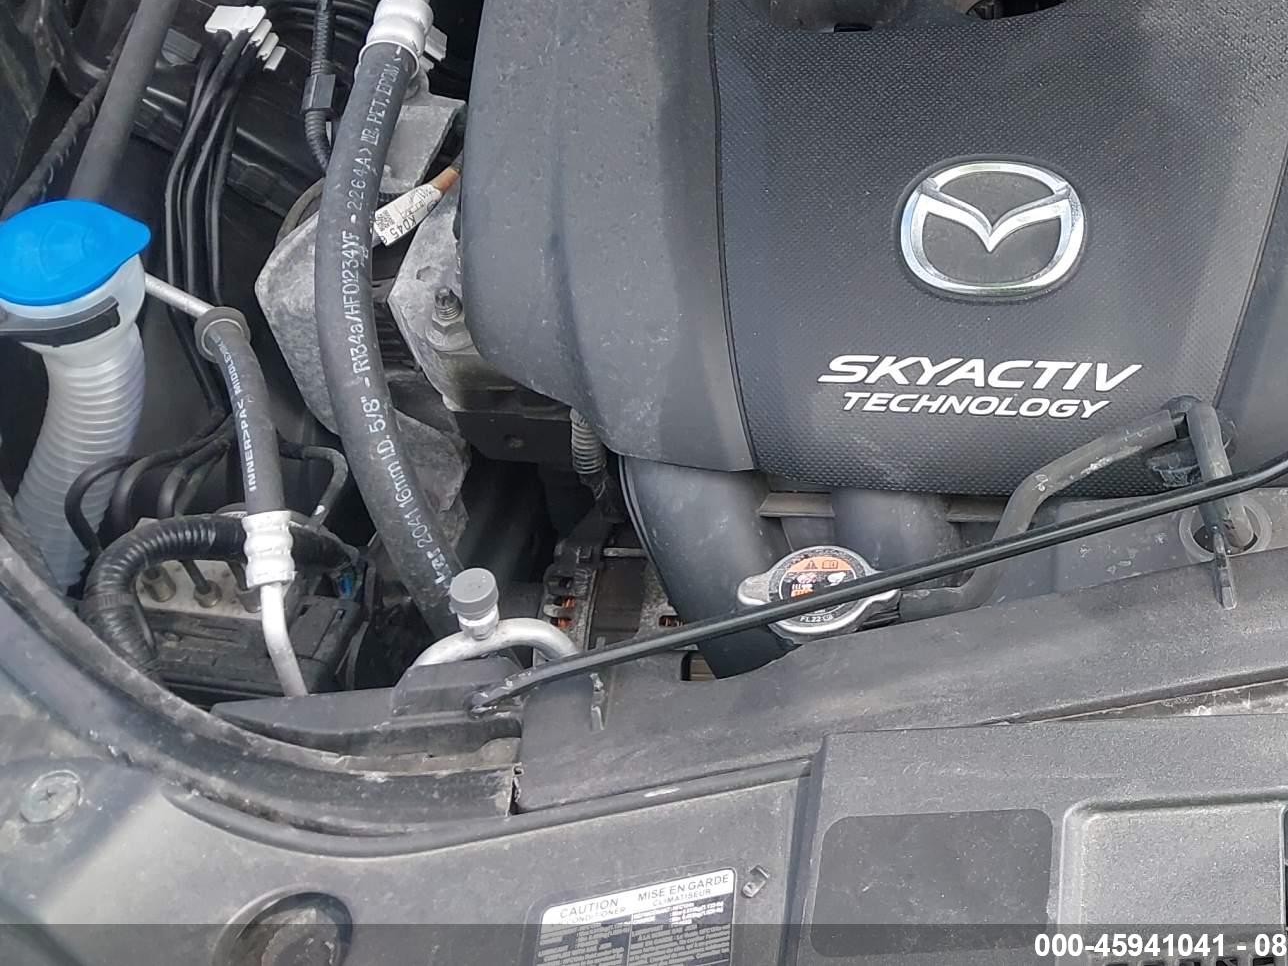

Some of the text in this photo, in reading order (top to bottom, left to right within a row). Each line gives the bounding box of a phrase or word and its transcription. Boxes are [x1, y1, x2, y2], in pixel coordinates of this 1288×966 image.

[817, 354, 1143, 392] SKYACTIV
[361, 396, 386, 435] 5/8"
[842, 391, 1111, 420] TECHNOLOGY
[388, 461, 414, 510] 16mm
[637, 874, 729, 902] MISE EN GARDE
[559, 897, 620, 919] CAUTION
